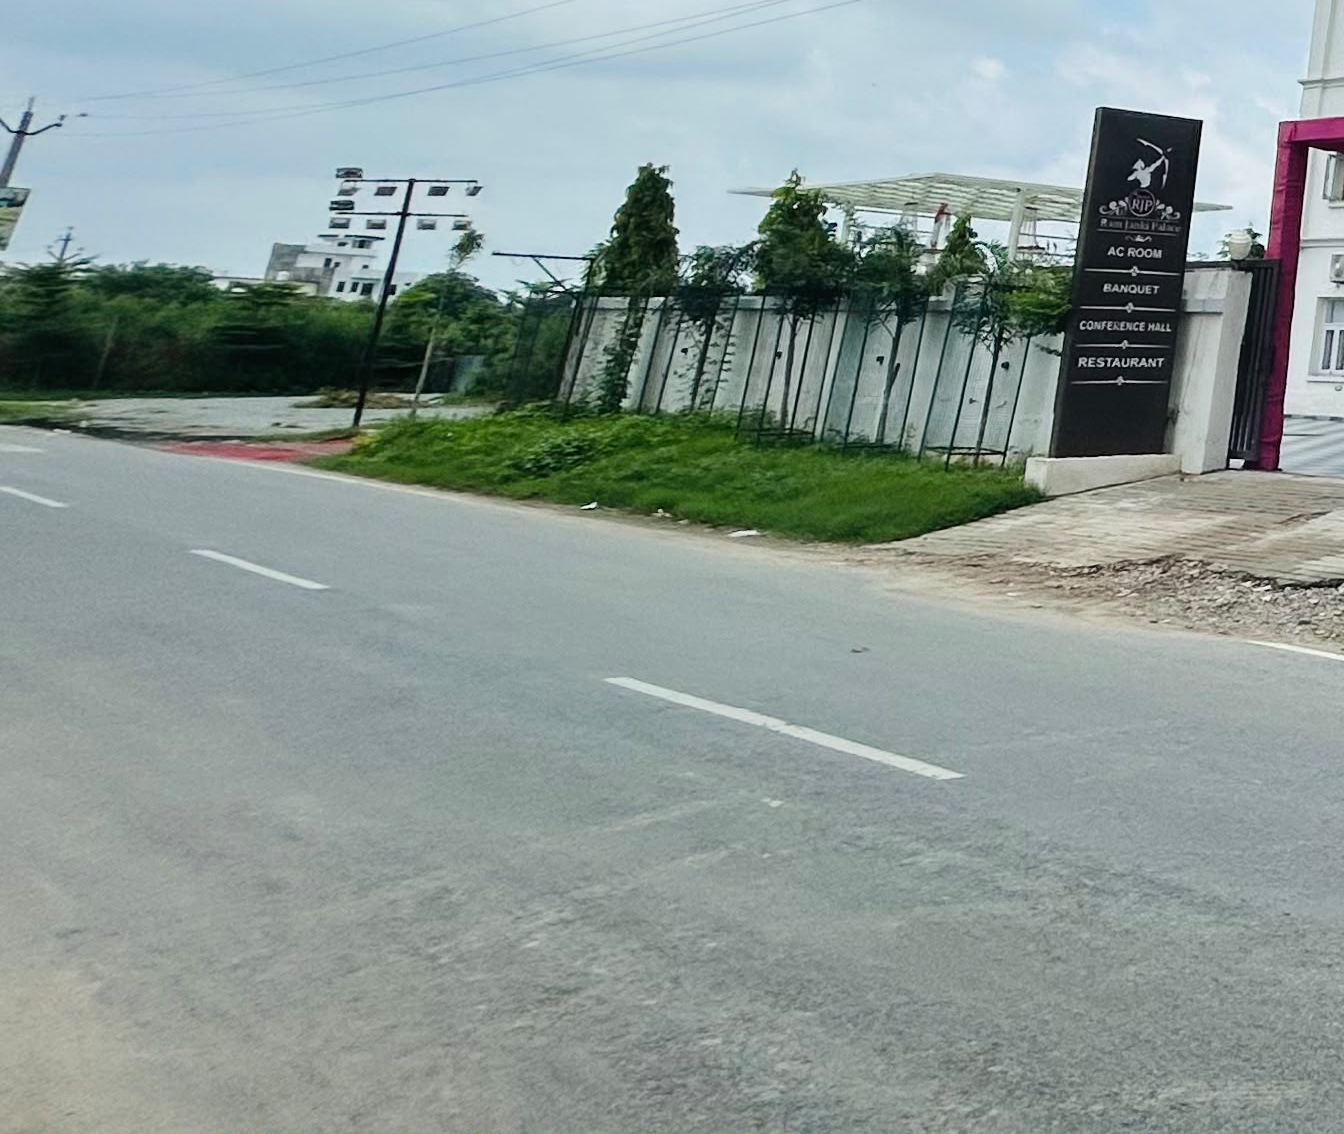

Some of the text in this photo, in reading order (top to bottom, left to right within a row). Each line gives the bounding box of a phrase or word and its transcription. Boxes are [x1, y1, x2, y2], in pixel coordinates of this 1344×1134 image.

[1131, 198, 1153, 213] RJP
[1107, 246, 1162, 259] AC ROOM
[1102, 283, 1160, 295] BANQUET
[1079, 320, 1172, 333] CONFERENCE HALL
[1077, 356, 1165, 368] RESTAURANT
